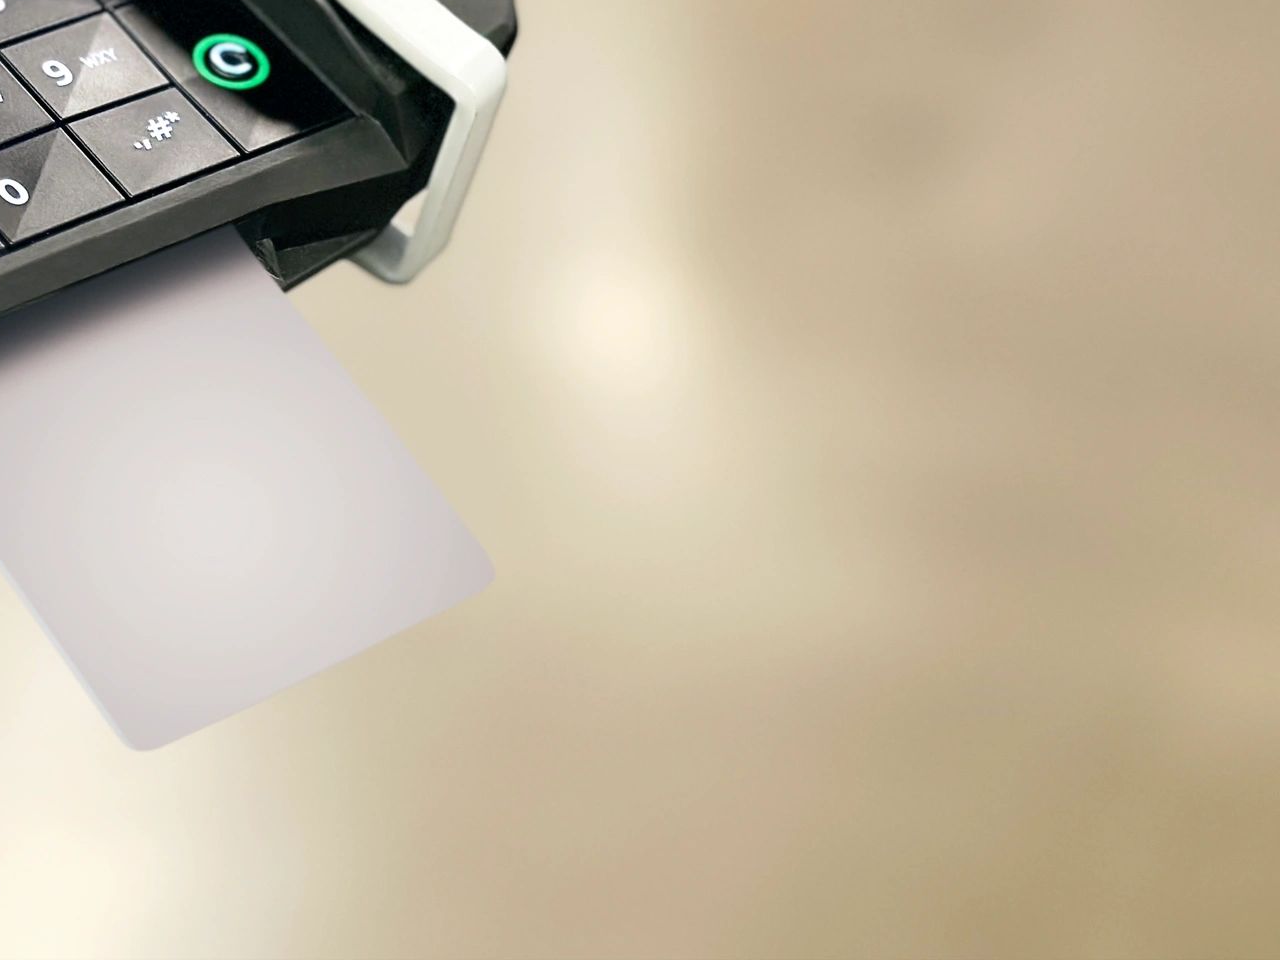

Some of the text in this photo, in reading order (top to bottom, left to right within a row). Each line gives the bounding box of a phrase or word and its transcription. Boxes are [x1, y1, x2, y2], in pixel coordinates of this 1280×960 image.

[41, 47, 118, 87] 9 WXY
[209, 42, 253, 75] C
